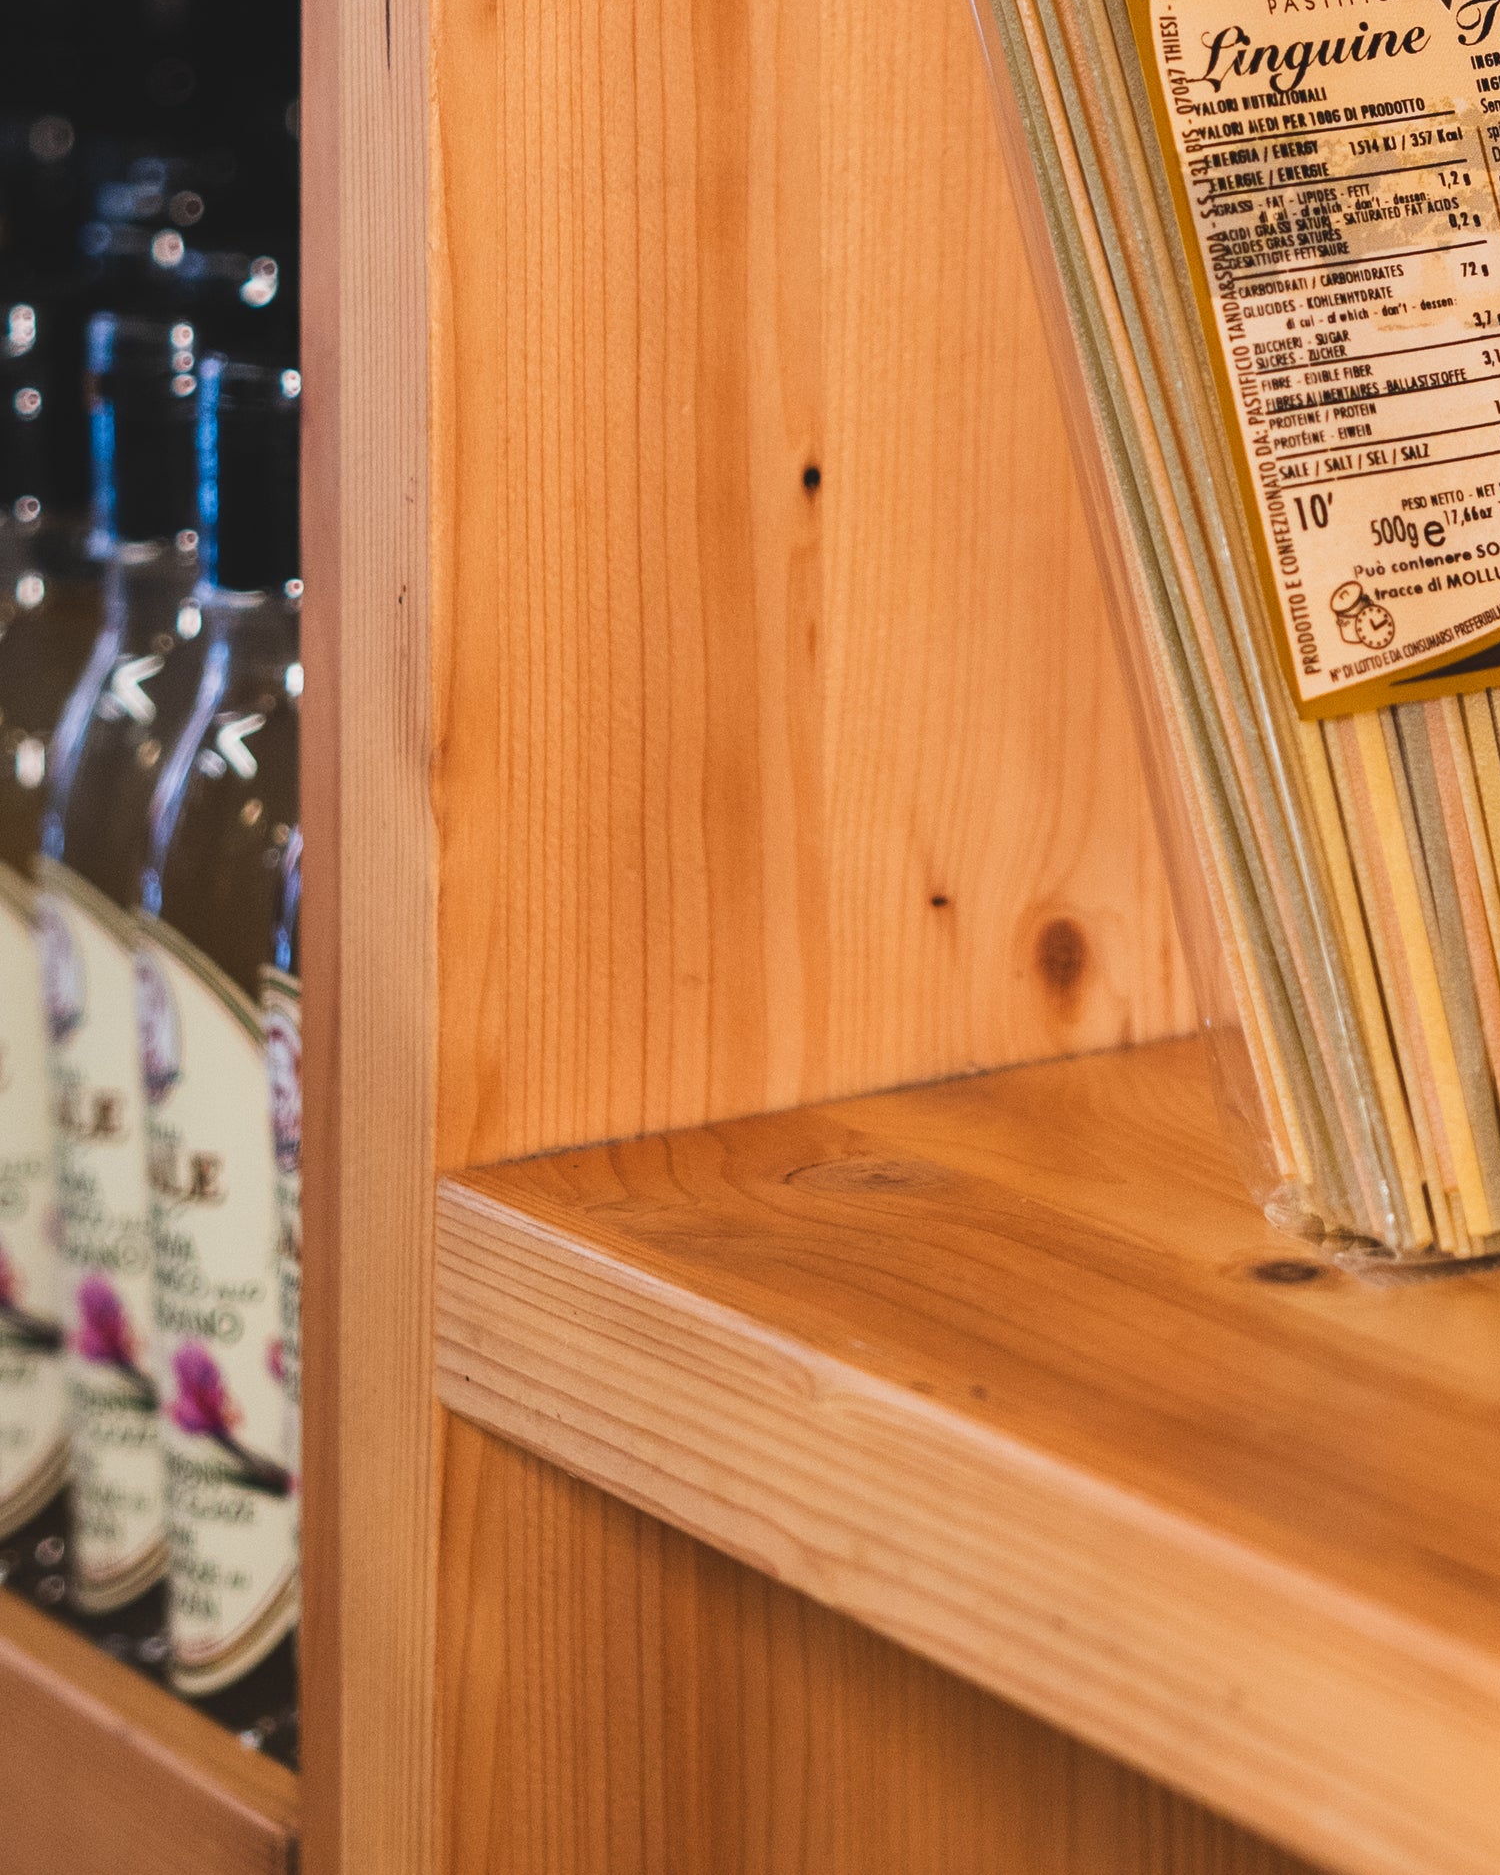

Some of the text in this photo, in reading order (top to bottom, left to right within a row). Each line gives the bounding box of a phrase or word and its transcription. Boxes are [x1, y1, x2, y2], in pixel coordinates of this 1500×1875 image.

[1159, 16, 1181, 62] THIESI
[1187, 25, 1433, 91] Linguine
[1198, 121, 1243, 139] VALORI
[1282, 113, 1306, 128] PER
[1343, 107, 1357, 120] DI
[1360, 97, 1424, 118] PRODOTTO
[1272, 131, 1431, 158] ENERGY 1514 357
[1266, 183, 1369, 207] FAT LIPIDES FETT
[1460, 261, 1477, 276] 72
[1243, 286, 1392, 318] GLUCIDES KOHLENHYDRATE
[1315, 310, 1490, 345] SUGAR 3,7
[1482, 349, 1500, 366] 3,1
[1230, 345, 1265, 425] PASTIFICIO
[1269, 403, 1375, 428] PROTEINE PROTEIN
[1253, 430, 1271, 456] DA:
[1279, 443, 1429, 479] SALE SALT SEL SALZ
[1401, 496, 1426, 509] PESO
[1430, 490, 1463, 505] NETTO
[1476, 484, 1494, 497] NET
[1257, 460, 1300, 575] CONFEZIONATO
[1371, 515, 1418, 548] 500g
[1353, 562, 1386, 580] Può
[1391, 551, 1471, 572] contenere
[1285, 580, 1301, 588] E
[1374, 584, 1422, 599] tracce
[1428, 577, 1441, 591] di
[1288, 594, 1320, 674] PRODOTTO
